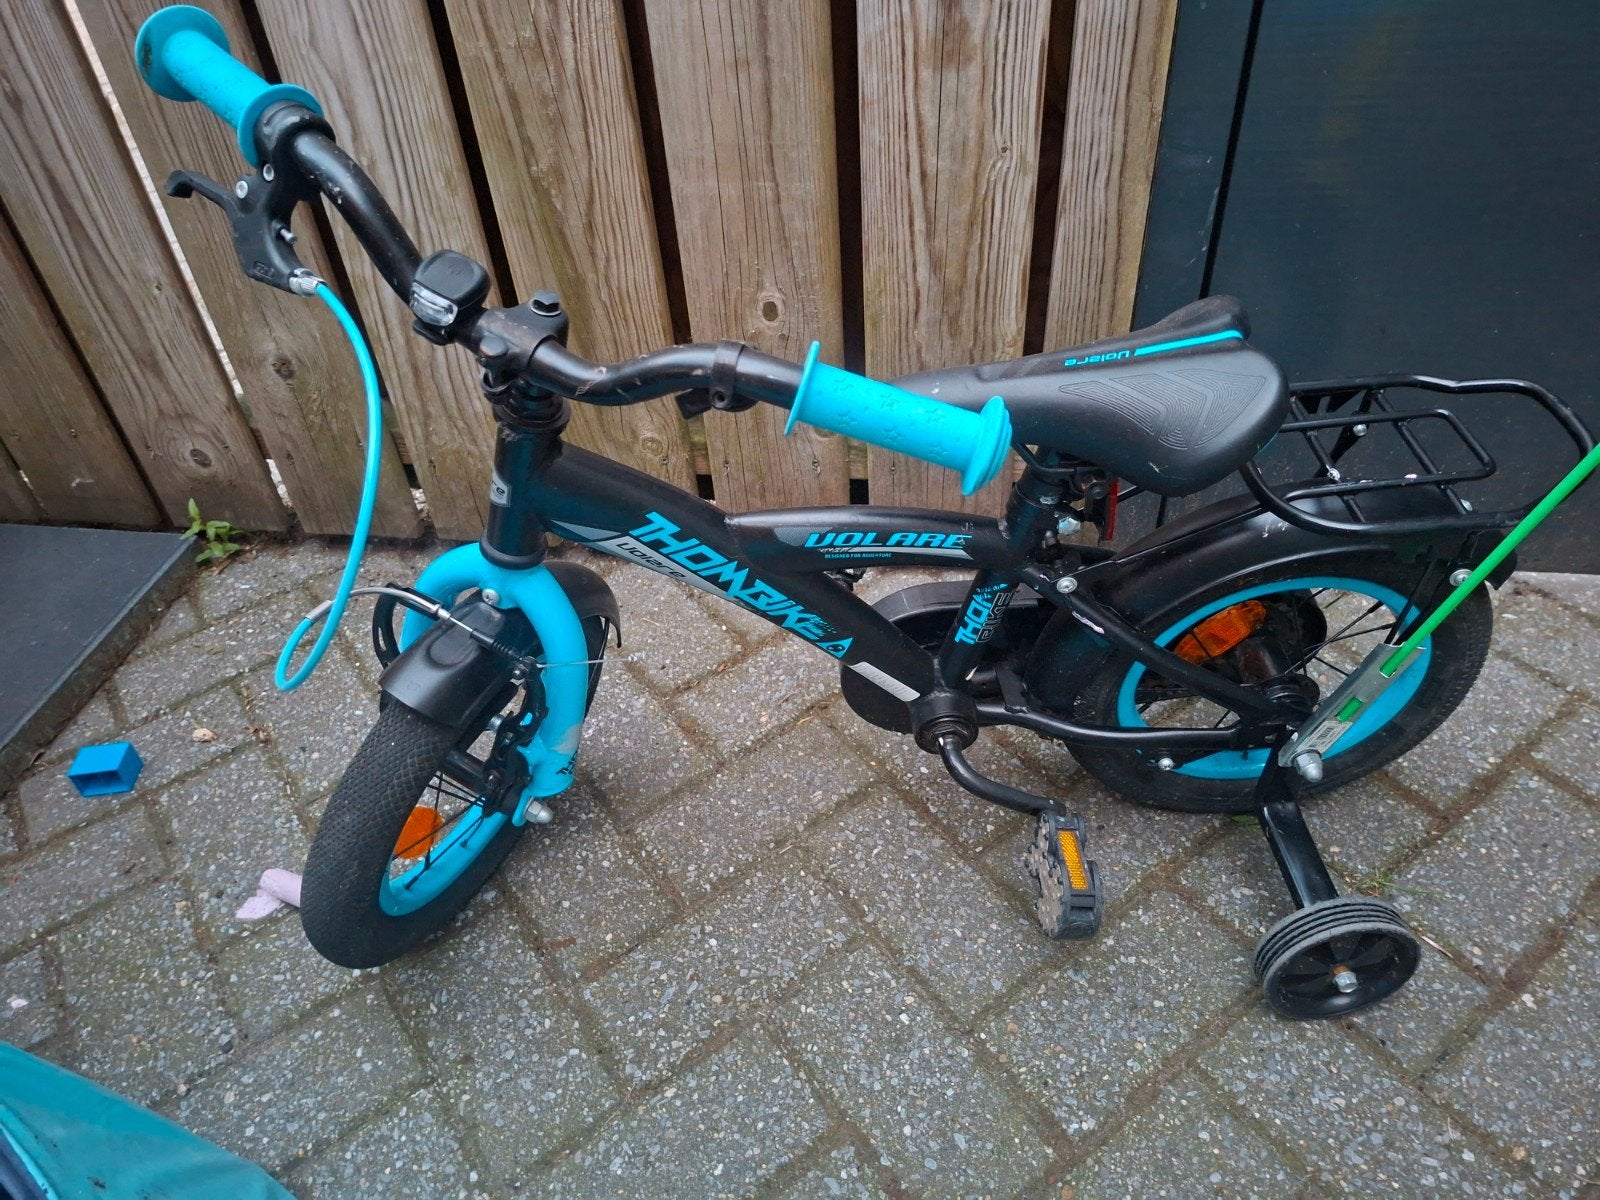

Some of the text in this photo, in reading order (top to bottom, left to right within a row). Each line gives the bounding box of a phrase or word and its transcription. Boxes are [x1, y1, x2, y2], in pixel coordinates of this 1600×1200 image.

[1064, 350, 1130, 366] Volare
[804, 532, 973, 549] VOLARE
[616, 542, 686, 578] Volare
[629, 511, 828, 640] THOMBIKE
